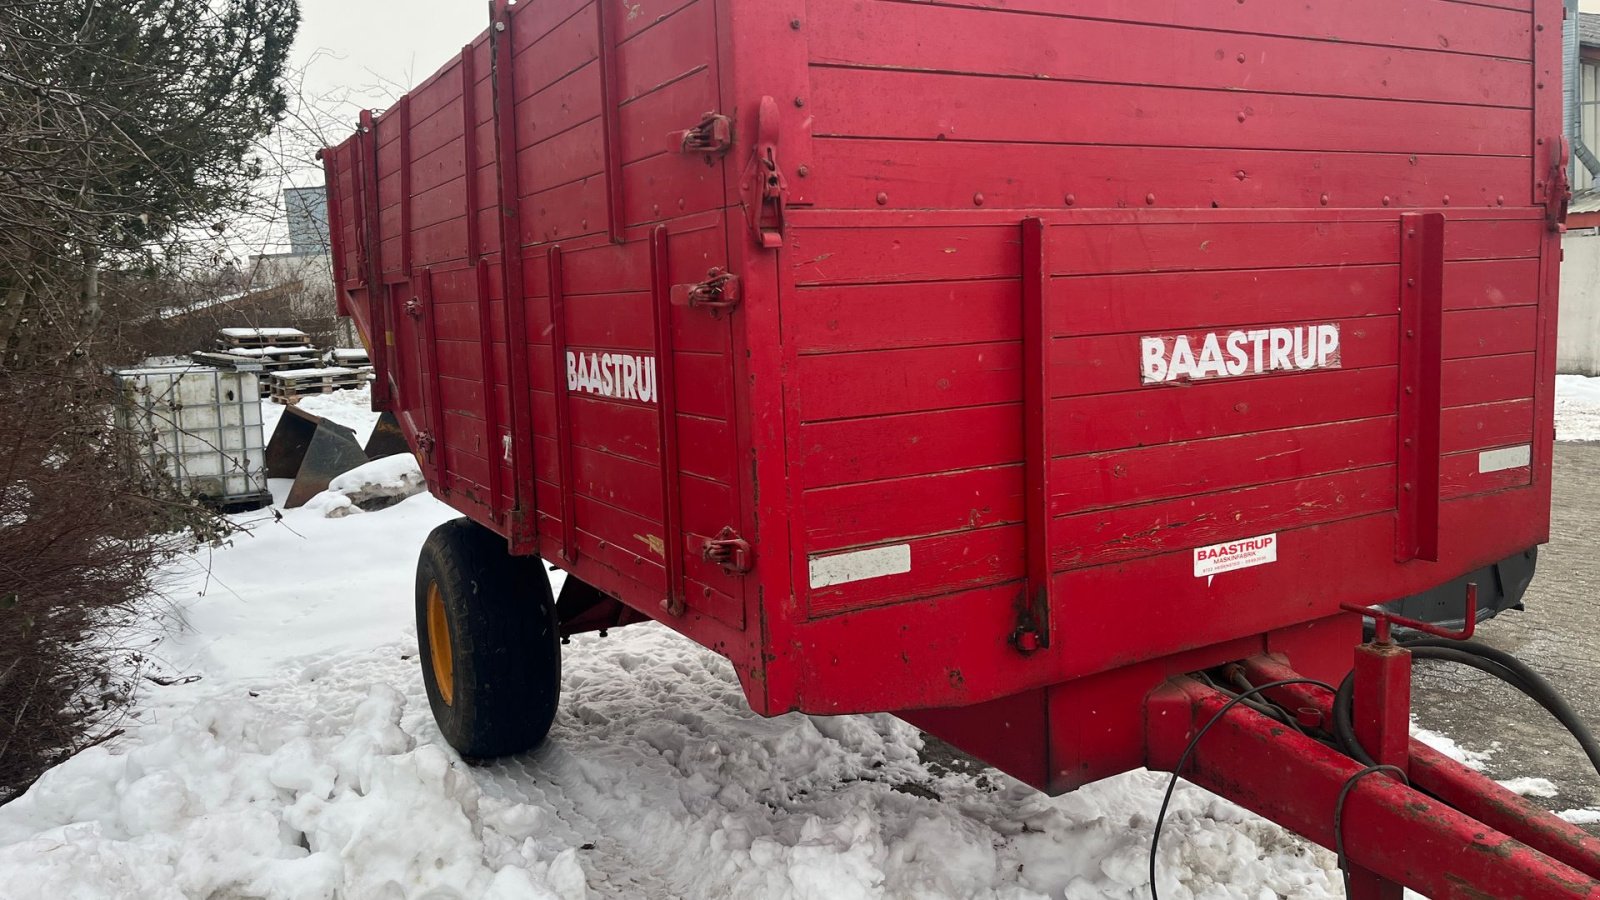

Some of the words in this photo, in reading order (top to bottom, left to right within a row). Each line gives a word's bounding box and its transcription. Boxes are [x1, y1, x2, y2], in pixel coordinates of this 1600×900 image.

[1141, 325, 1339, 383] BAASTRUP
[1197, 537, 1273, 561] BAASTRUP
[1213, 551, 1257, 564] MASKINFABRIK
